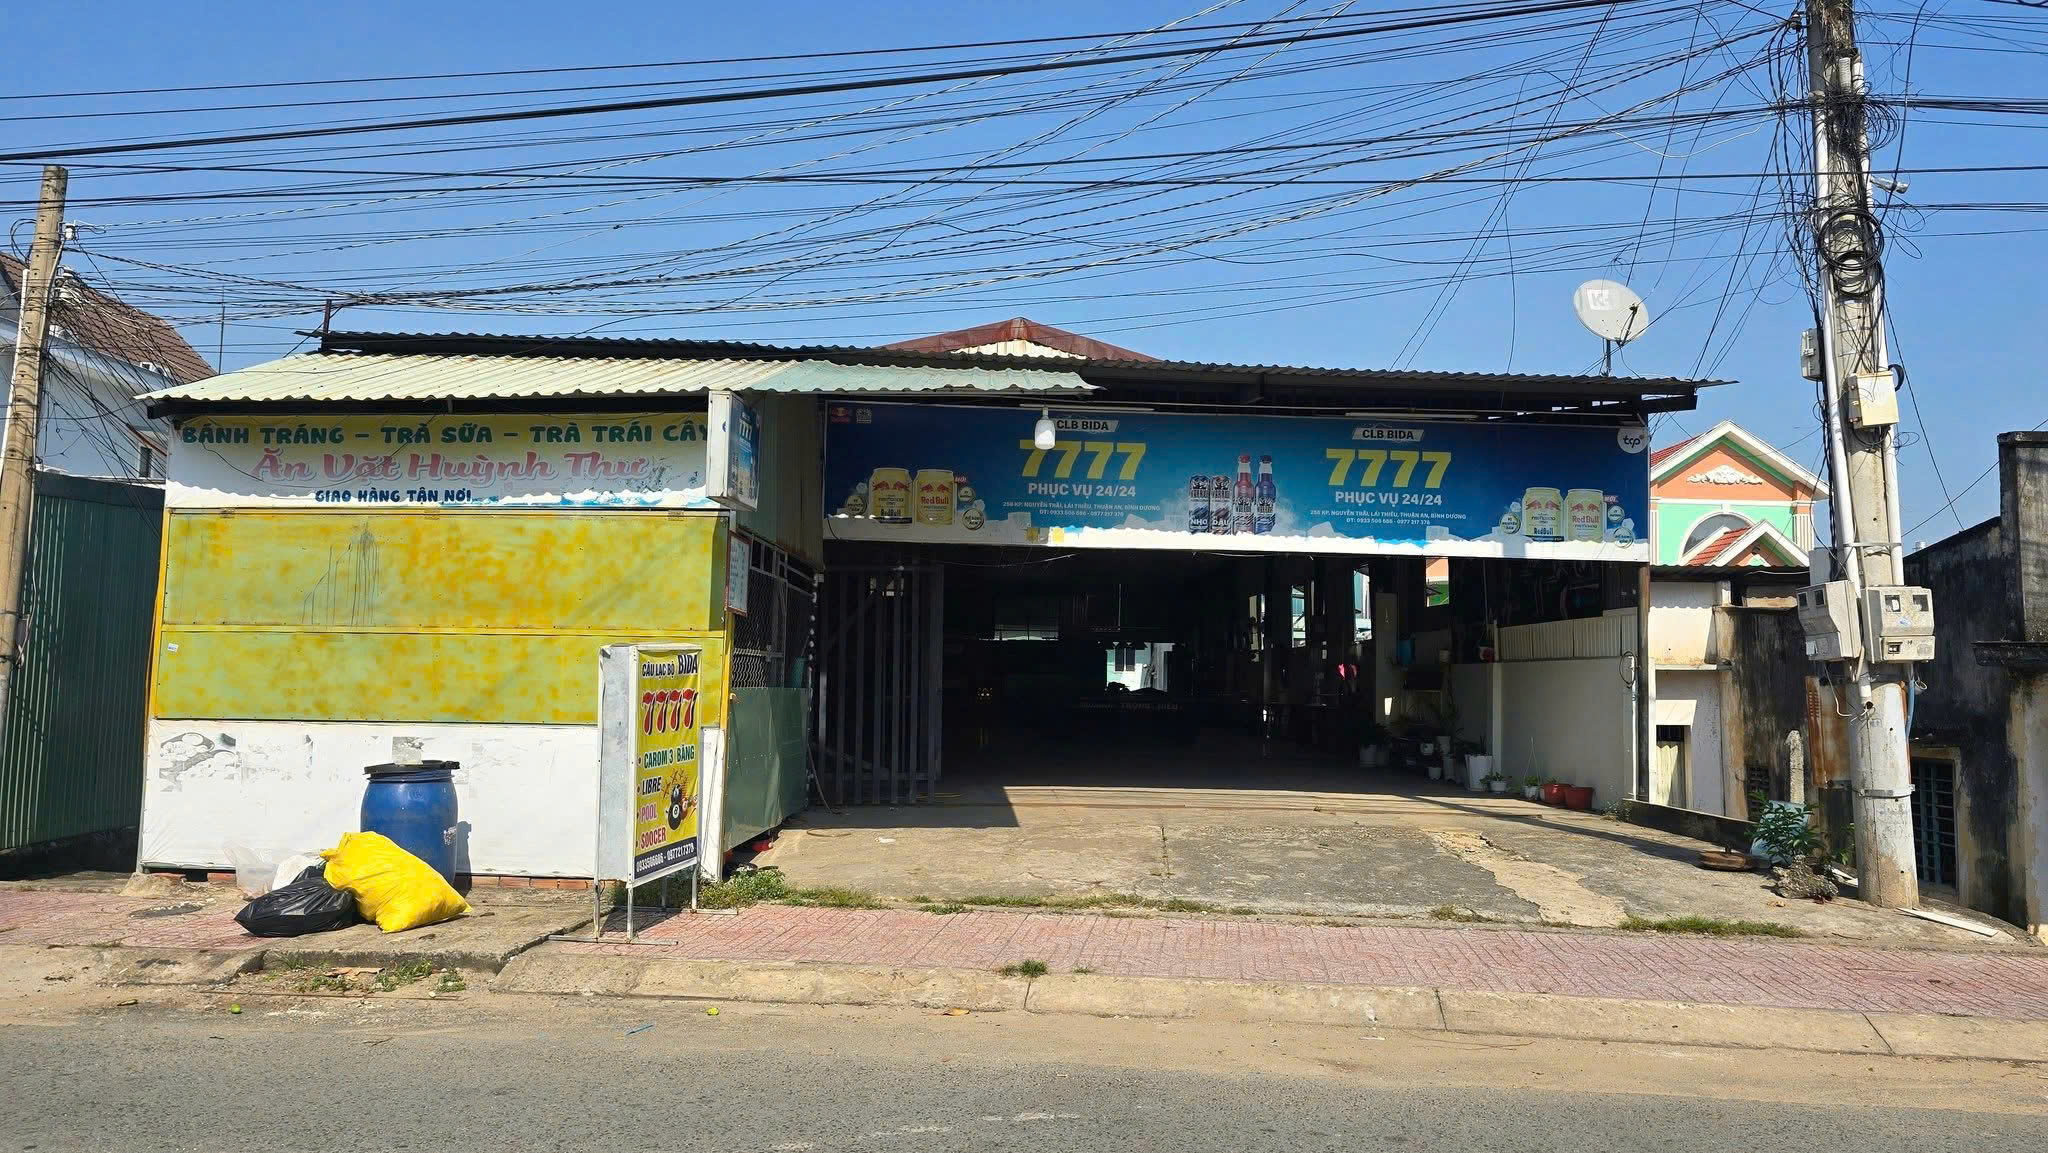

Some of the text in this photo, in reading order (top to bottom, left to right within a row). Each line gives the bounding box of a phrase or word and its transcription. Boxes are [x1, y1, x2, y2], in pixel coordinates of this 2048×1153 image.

[183, 423, 249, 444] BÁNH
[260, 423, 345, 444] TRÁNG
[441, 422, 493, 443] SỮA
[529, 422, 581, 443] TRÀ
[591, 421, 653, 443] TRÁI
[1057, 419, 1109, 431] CLB BIDA
[1362, 429, 1415, 440] CLB BIDA
[1623, 436, 1641, 448] tcp
[250, 447, 650, 487] Ăn Vật Huỳnh Thư
[1019, 440, 1146, 480] 7777
[1326, 448, 1451, 488] 7777
[315, 490, 350, 503] GIAO
[357, 487, 400, 503] HÀNG
[406, 487, 438, 505] TẬN
[1028, 483, 1136, 499] PHỤC VỤ 24/24
[1335, 491, 1442, 507] PHỤC VỤ 24/24
[655, 664, 667, 679] LẠC
[667, 661, 675, 679] BỘ
[677, 654, 698, 674] BIDA
[642, 688, 698, 735] 7777
[644, 744, 695, 769] CAROM 3 BĂNG
[642, 777, 661, 795] LIBRE
[641, 804, 657, 822] POOL
